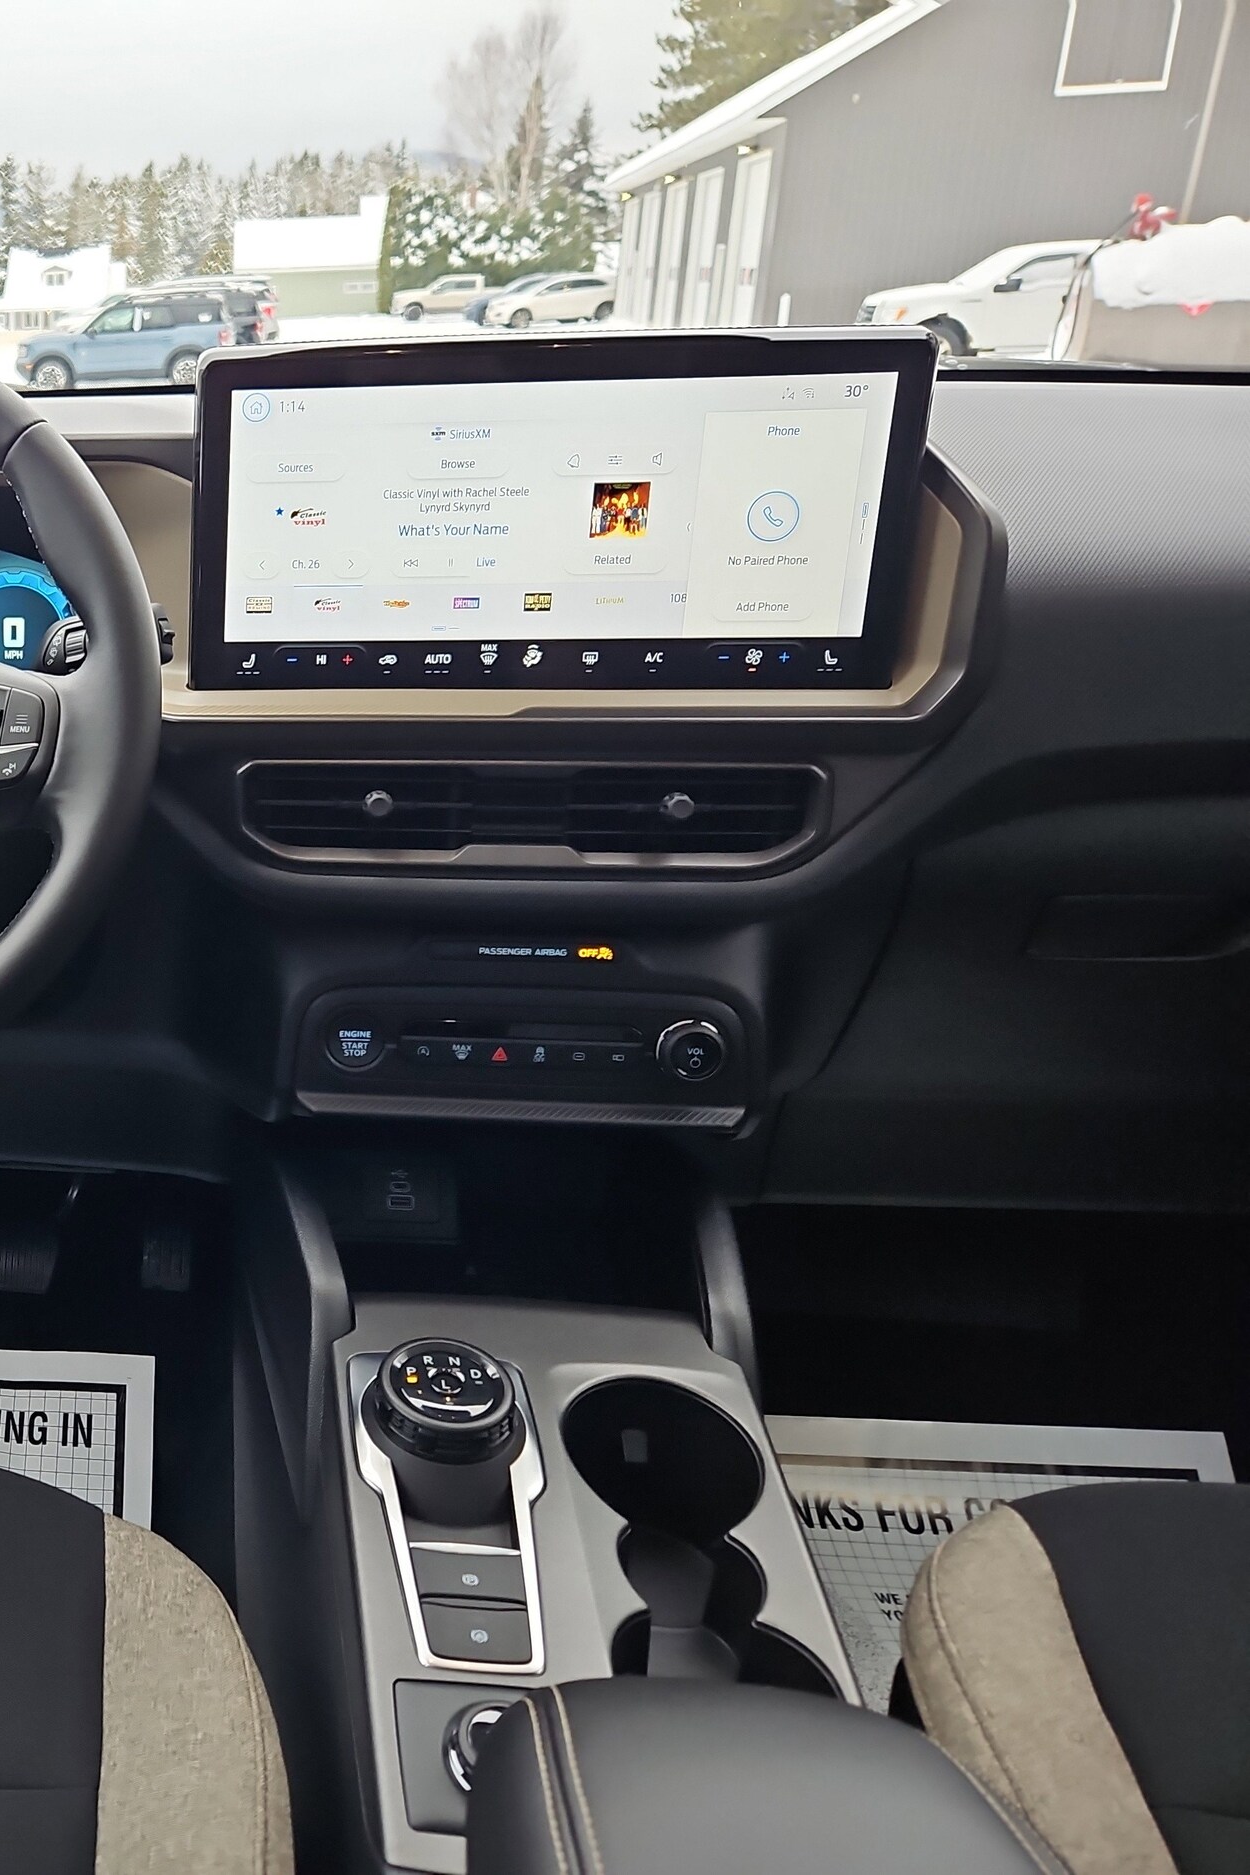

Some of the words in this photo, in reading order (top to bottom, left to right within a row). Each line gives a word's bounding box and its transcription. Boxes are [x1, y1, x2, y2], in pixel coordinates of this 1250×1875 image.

[279, 400, 306, 413] 1:14
[449, 428, 491, 440] SiriusXM
[767, 425, 801, 437] Phone
[278, 463, 314, 473] Sources
[440, 459, 476, 469] Browse
[383, 489, 414, 499] Classic
[416, 488, 440, 500] Vinyl
[442, 487, 463, 498] with
[465, 487, 497, 497] Rachel
[499, 486, 530, 497] Steele
[419, 502, 451, 514] Lynyrd
[453, 501, 491, 514] Skynyrd
[299, 510, 327, 519] Classic
[293, 518, 327, 527] vinyl
[398, 523, 441, 537] What's
[443, 523, 471, 536] Your
[472, 523, 510, 536] Name
[291, 559, 306, 569] Ch.
[308, 559, 320, 569] 26
[476, 556, 496, 567] Live
[593, 554, 632, 565] Related
[727, 556, 742, 566] No
[744, 555, 775, 566] Paired
[776, 555, 809, 566] Phone
[735, 602, 756, 612] Add
[758, 601, 789, 612] Phone
[2, 616, 26, 648] 0
[480, 643, 498, 652] MAX
[4, 650, 24, 660] MPH
[316, 654, 327, 665] HI
[424, 653, 452, 665] AUTO
[645, 652, 664, 664] A/C
[9, 725, 31, 733] MENU
[478, 946, 532, 956] PASSENGER
[534, 948, 568, 957] AIRBAG
[578, 948, 599, 958] OFF
[338, 1030, 372, 1039] ENGINE
[341, 1041, 369, 1050] START
[452, 1044, 472, 1052] MAX
[343, 1049, 367, 1057] STOP
[686, 1047, 705, 1056] VOL
[422, 1355, 434, 1365] R
[448, 1356, 461, 1366] N
[406, 1366, 417, 1376] P
[469, 1368, 482, 1379] D
[440, 1379, 451, 1390] L
[60, 1412, 94, 1449] IN
[874, 1591, 903, 1606] WE
